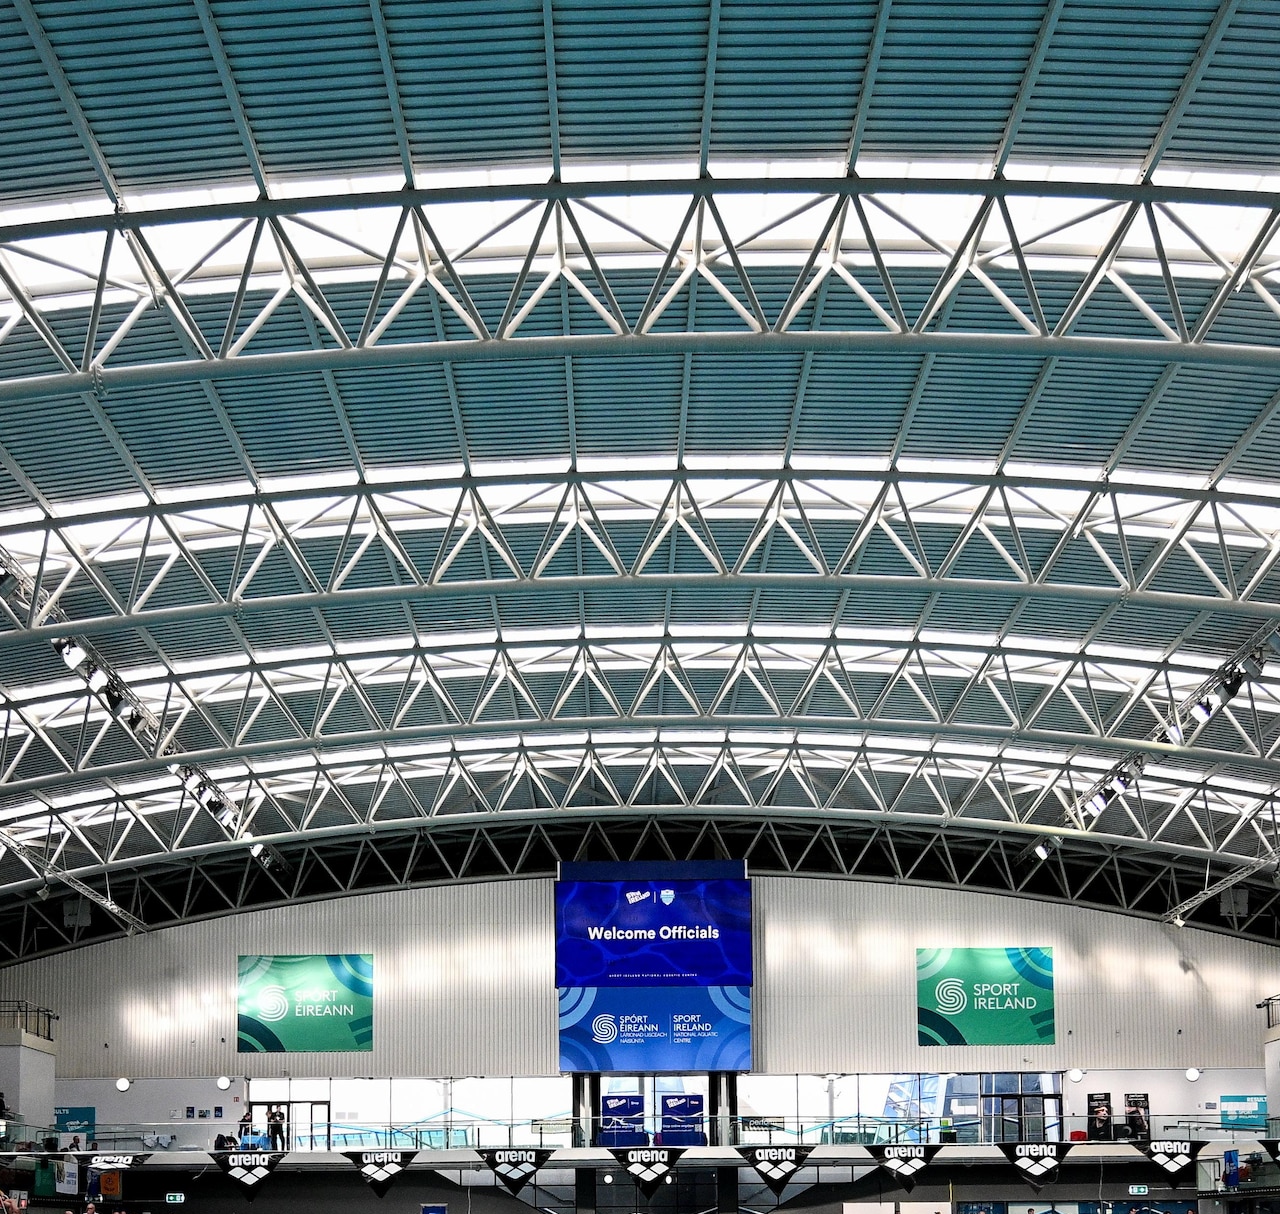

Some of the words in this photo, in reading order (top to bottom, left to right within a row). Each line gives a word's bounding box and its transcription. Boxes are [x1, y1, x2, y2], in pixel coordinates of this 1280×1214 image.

[588, 926, 656, 940] Welcome
[659, 925, 720, 940] Officials
[973, 983, 1020, 996] SPORT
[974, 997, 1037, 1010] IRELAND
[295, 1003, 354, 1017] ÉIREANN
[673, 1014, 701, 1023] SPORT
[673, 1023, 711, 1031] IRELAND
[884, 1145, 924, 1157] arena
[1015, 1144, 1056, 1156] arena
[1150, 1141, 1190, 1153] arena
[230, 1154, 269, 1166] arena
[362, 1152, 401, 1163] arena
[495, 1151, 535, 1162] arena
[628, 1150, 668, 1162] arena
[755, 1148, 796, 1160] arena
